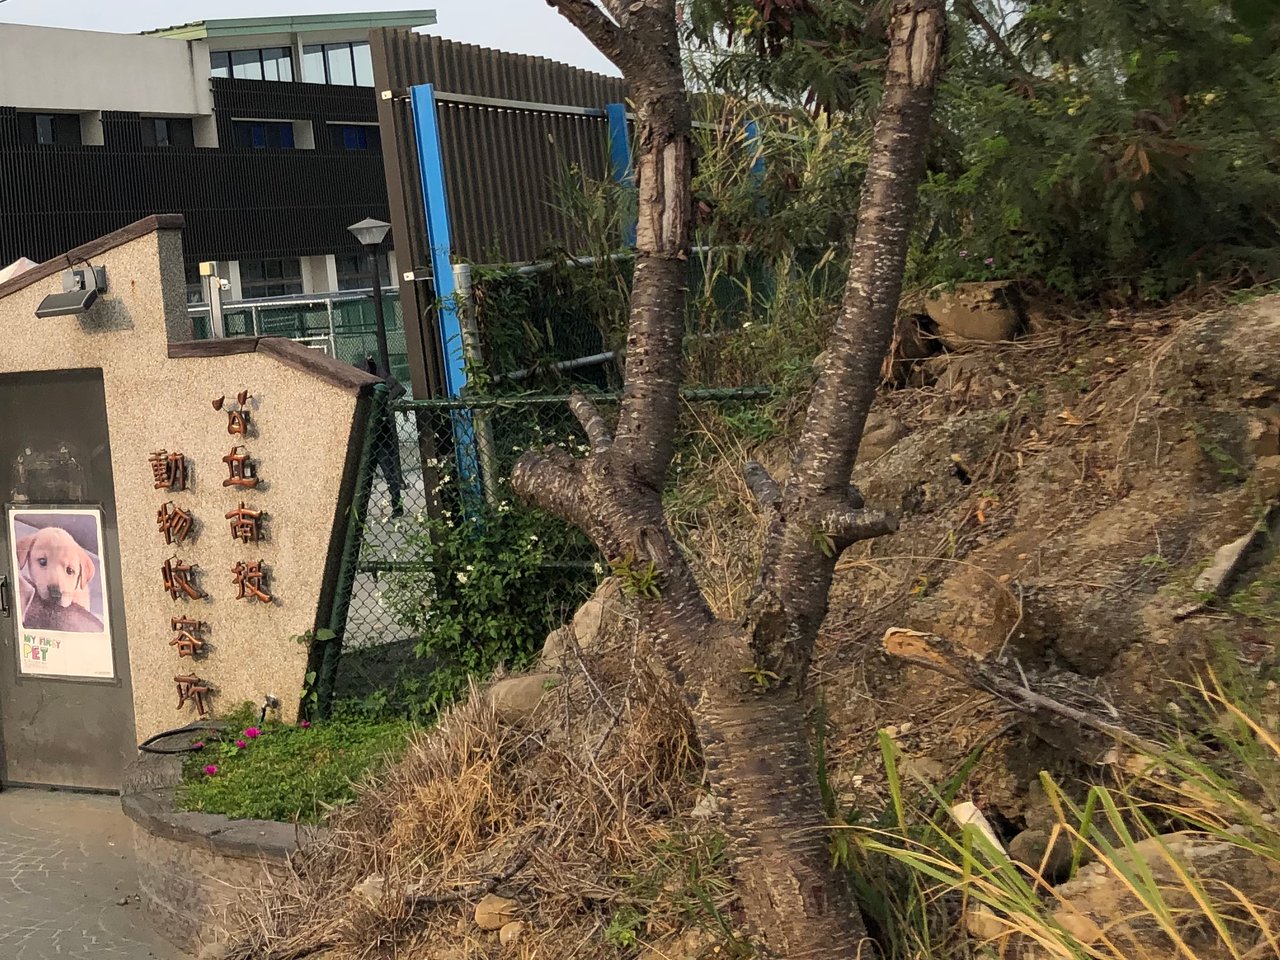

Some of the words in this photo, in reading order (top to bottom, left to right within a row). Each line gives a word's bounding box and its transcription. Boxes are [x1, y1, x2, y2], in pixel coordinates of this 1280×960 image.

[148, 448, 210, 716] 動物收容所
[211, 390, 271, 603] 公立南投
[23, 643, 49, 661] PET
